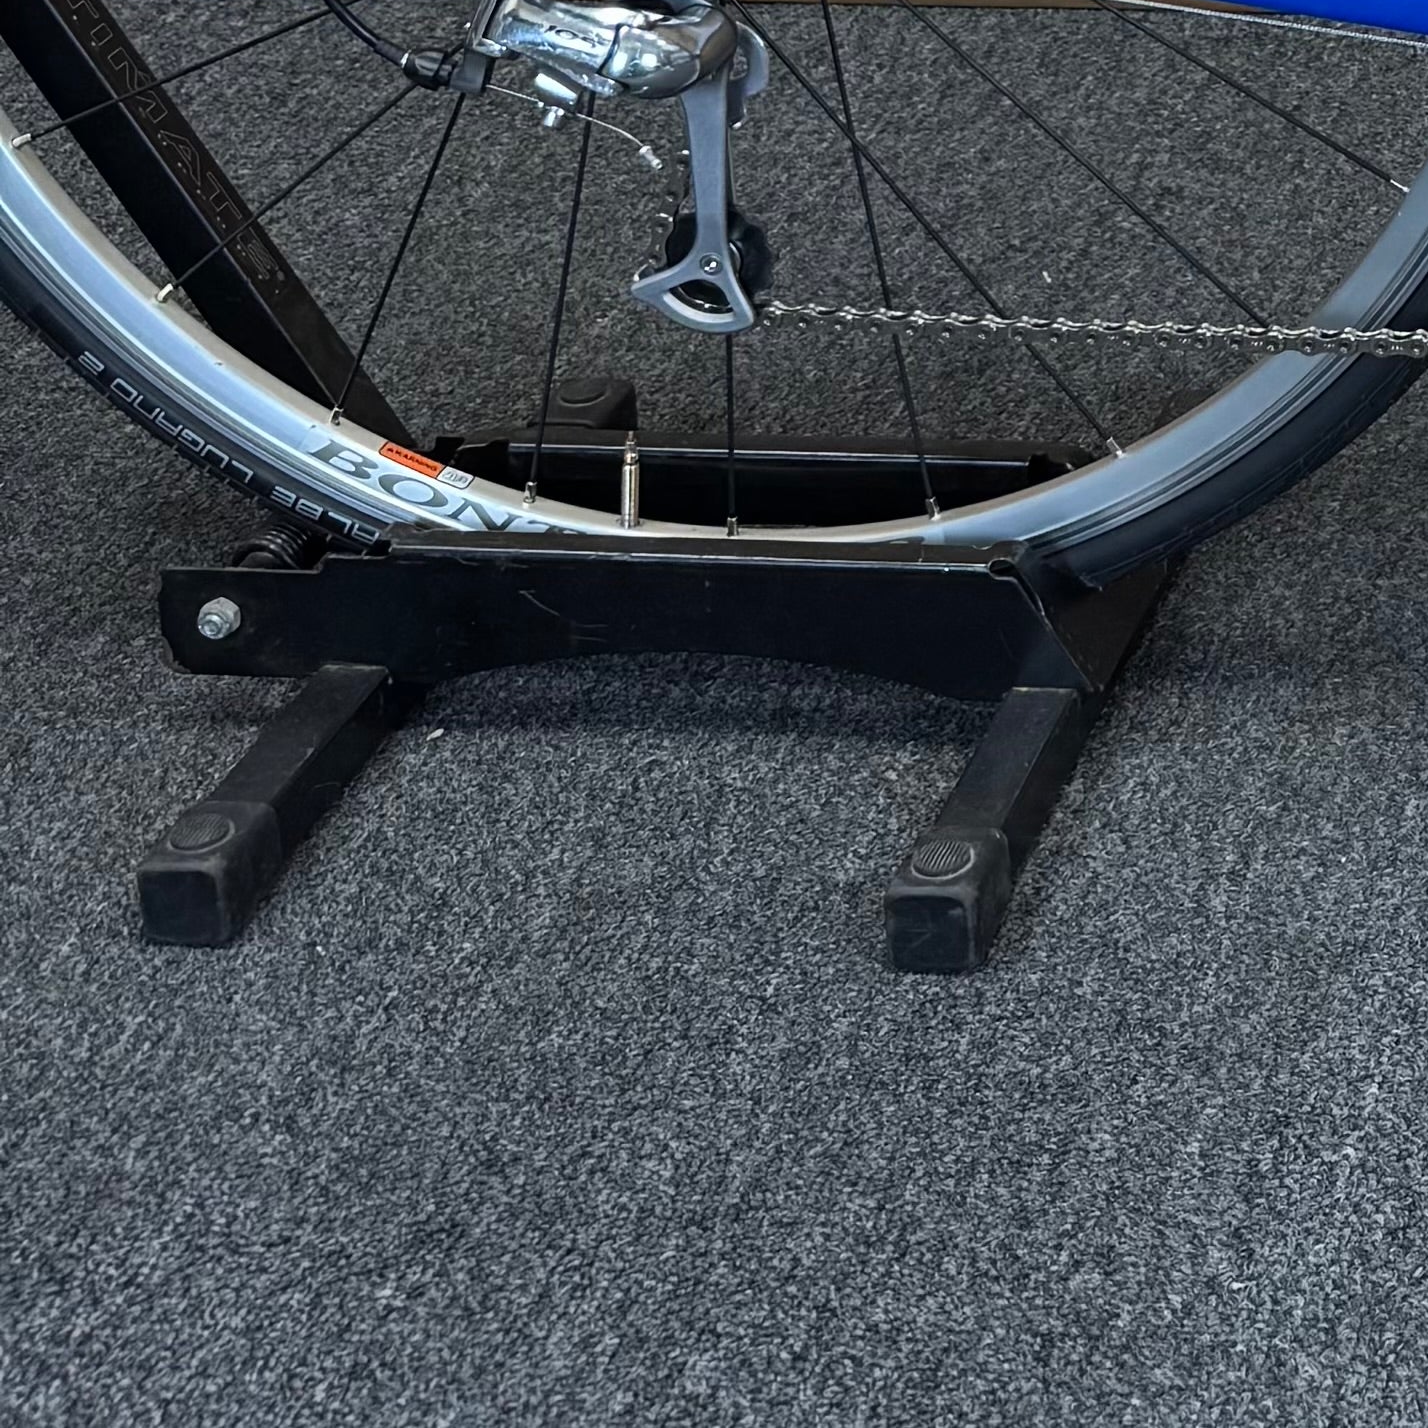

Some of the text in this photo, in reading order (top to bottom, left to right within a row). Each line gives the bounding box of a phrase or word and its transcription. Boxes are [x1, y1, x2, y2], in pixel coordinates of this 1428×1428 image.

[77, 350, 103, 374] 2
[110, 376, 254, 490] LUGANO
[305, 436, 582, 533] BON
